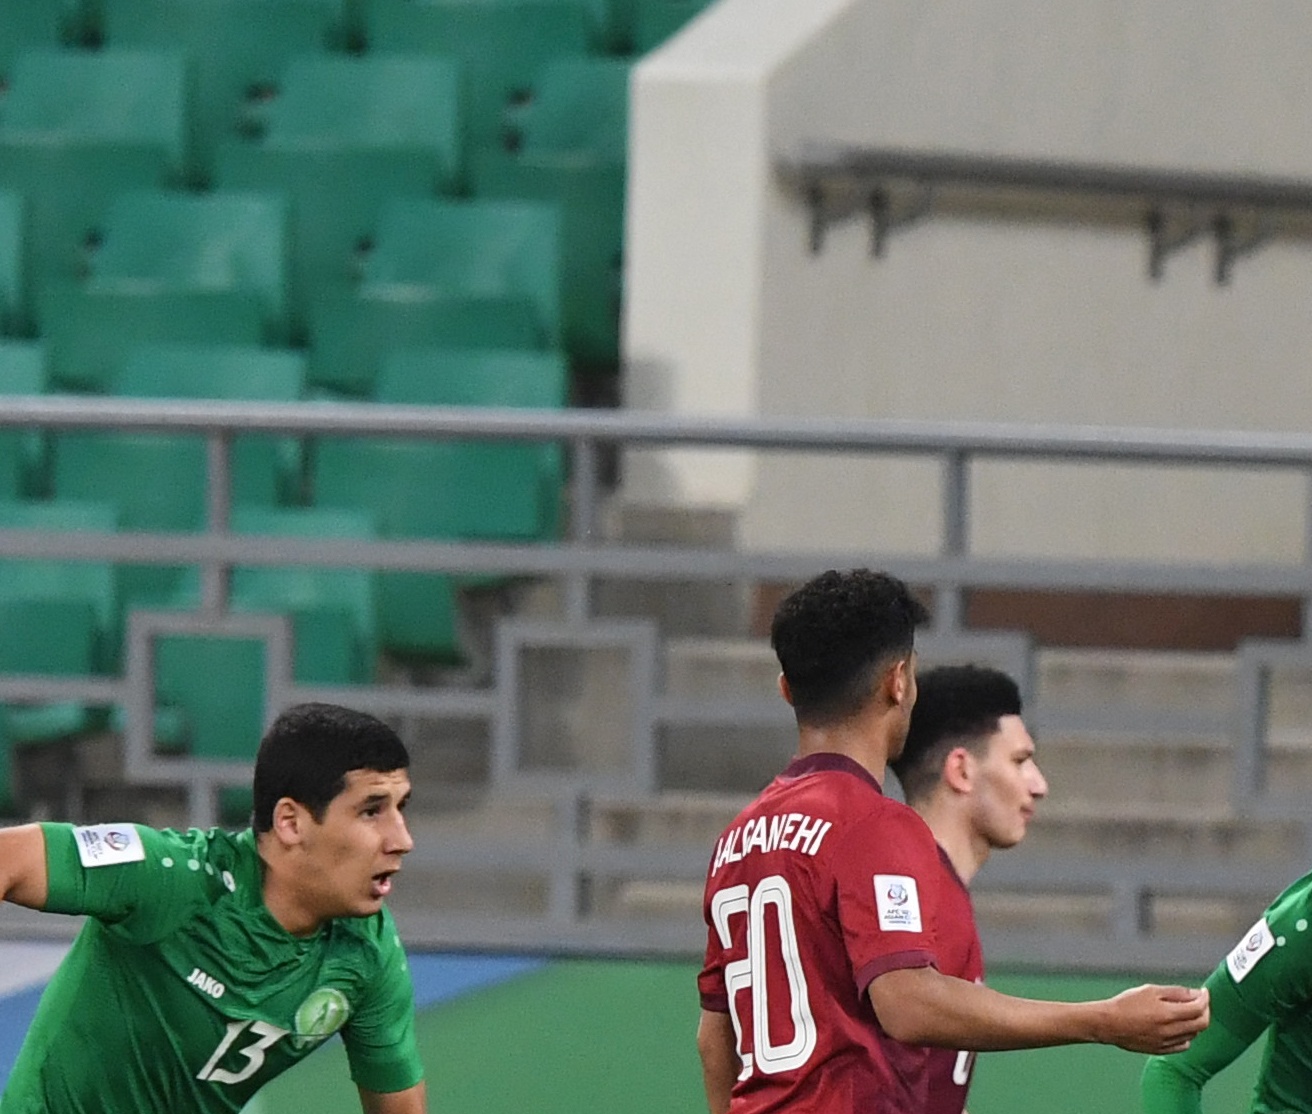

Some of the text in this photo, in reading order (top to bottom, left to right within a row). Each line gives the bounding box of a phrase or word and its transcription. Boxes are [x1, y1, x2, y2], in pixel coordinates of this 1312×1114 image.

[186, 967, 226, 999] JAKO
[711, 875, 817, 1081] 20
[196, 1019, 291, 1085] 13
